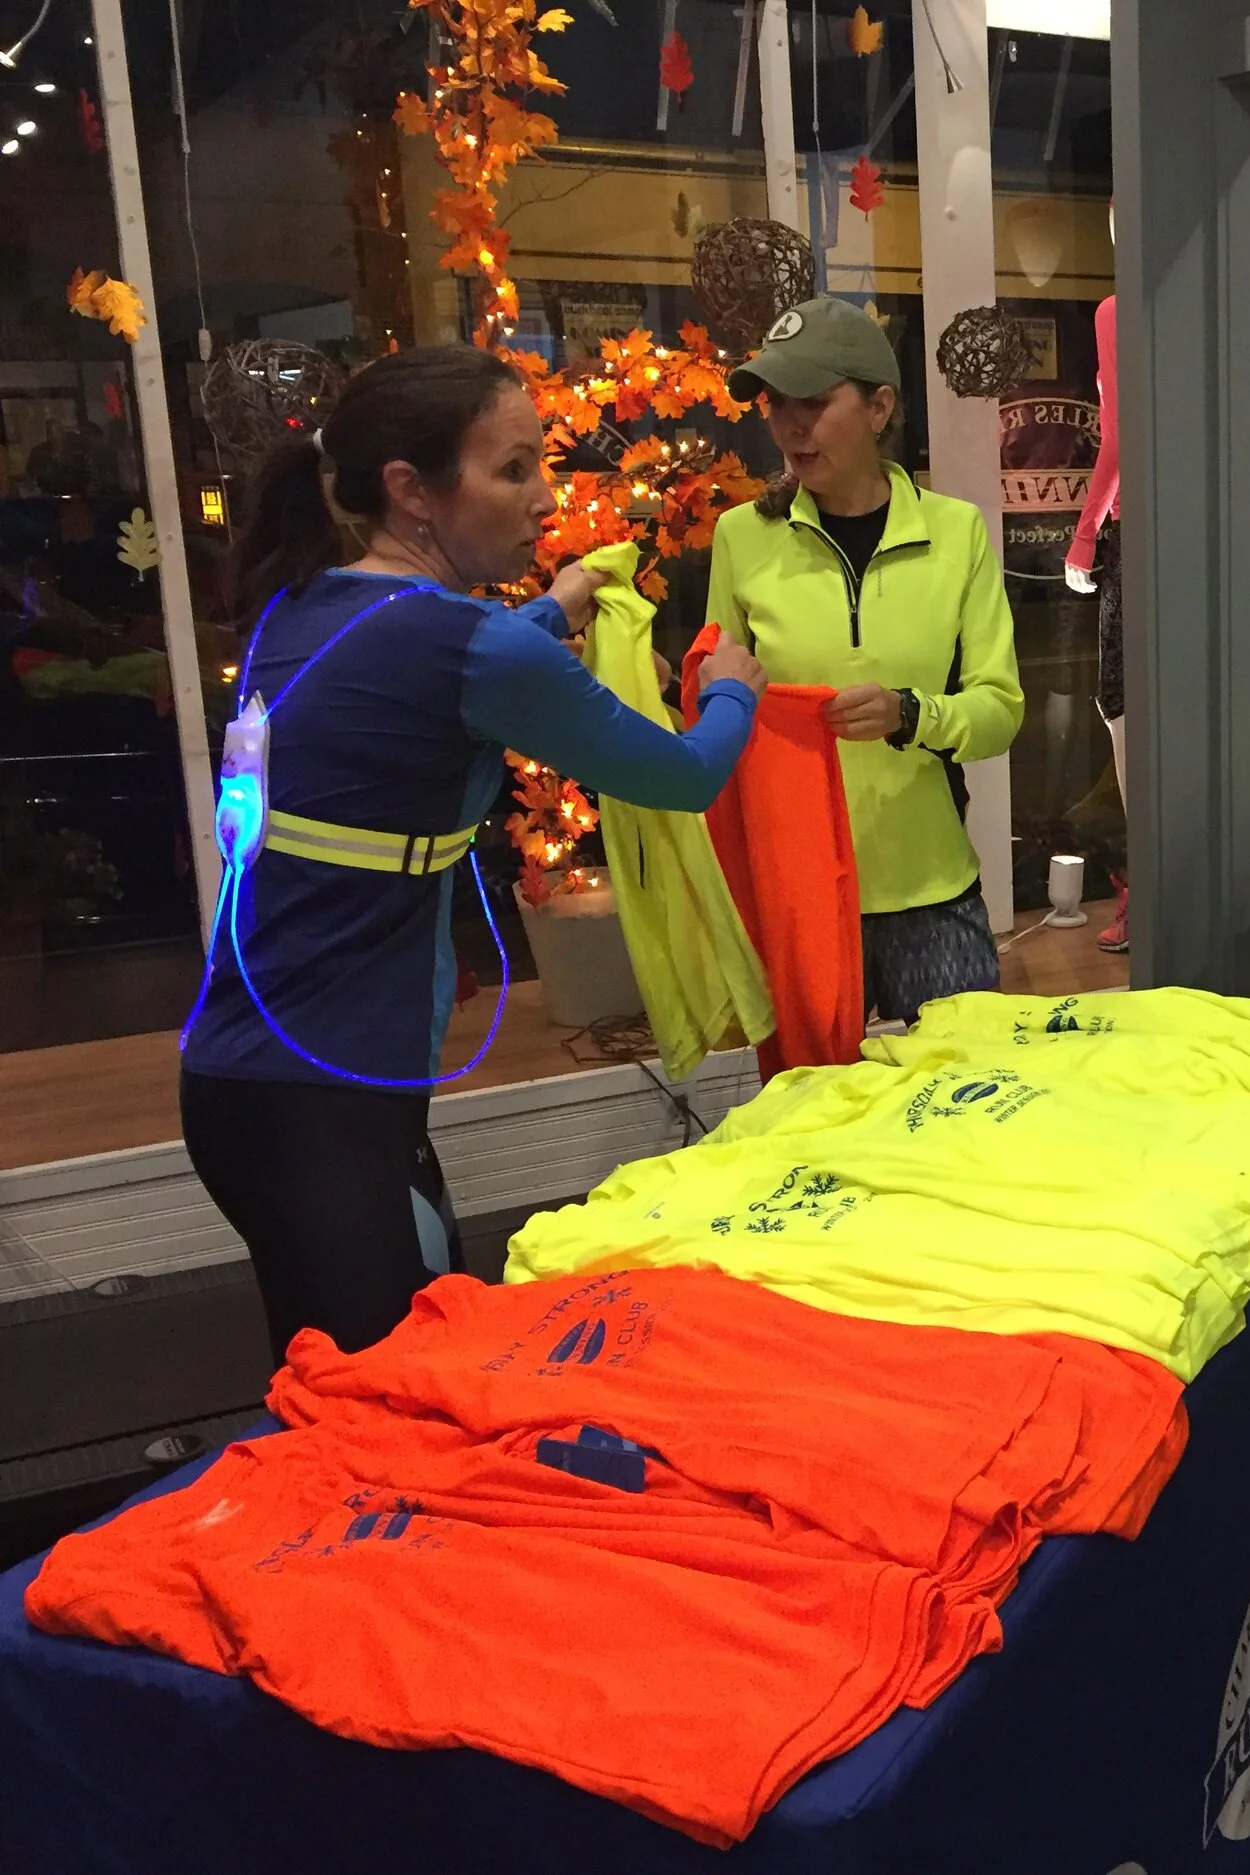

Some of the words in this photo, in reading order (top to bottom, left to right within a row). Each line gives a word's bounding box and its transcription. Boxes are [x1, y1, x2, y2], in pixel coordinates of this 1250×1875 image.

[1006, 1085, 1033, 1099] CLUB
[994, 1106, 1018, 1124] WINTER
[617, 1301, 648, 1345] CLUB
